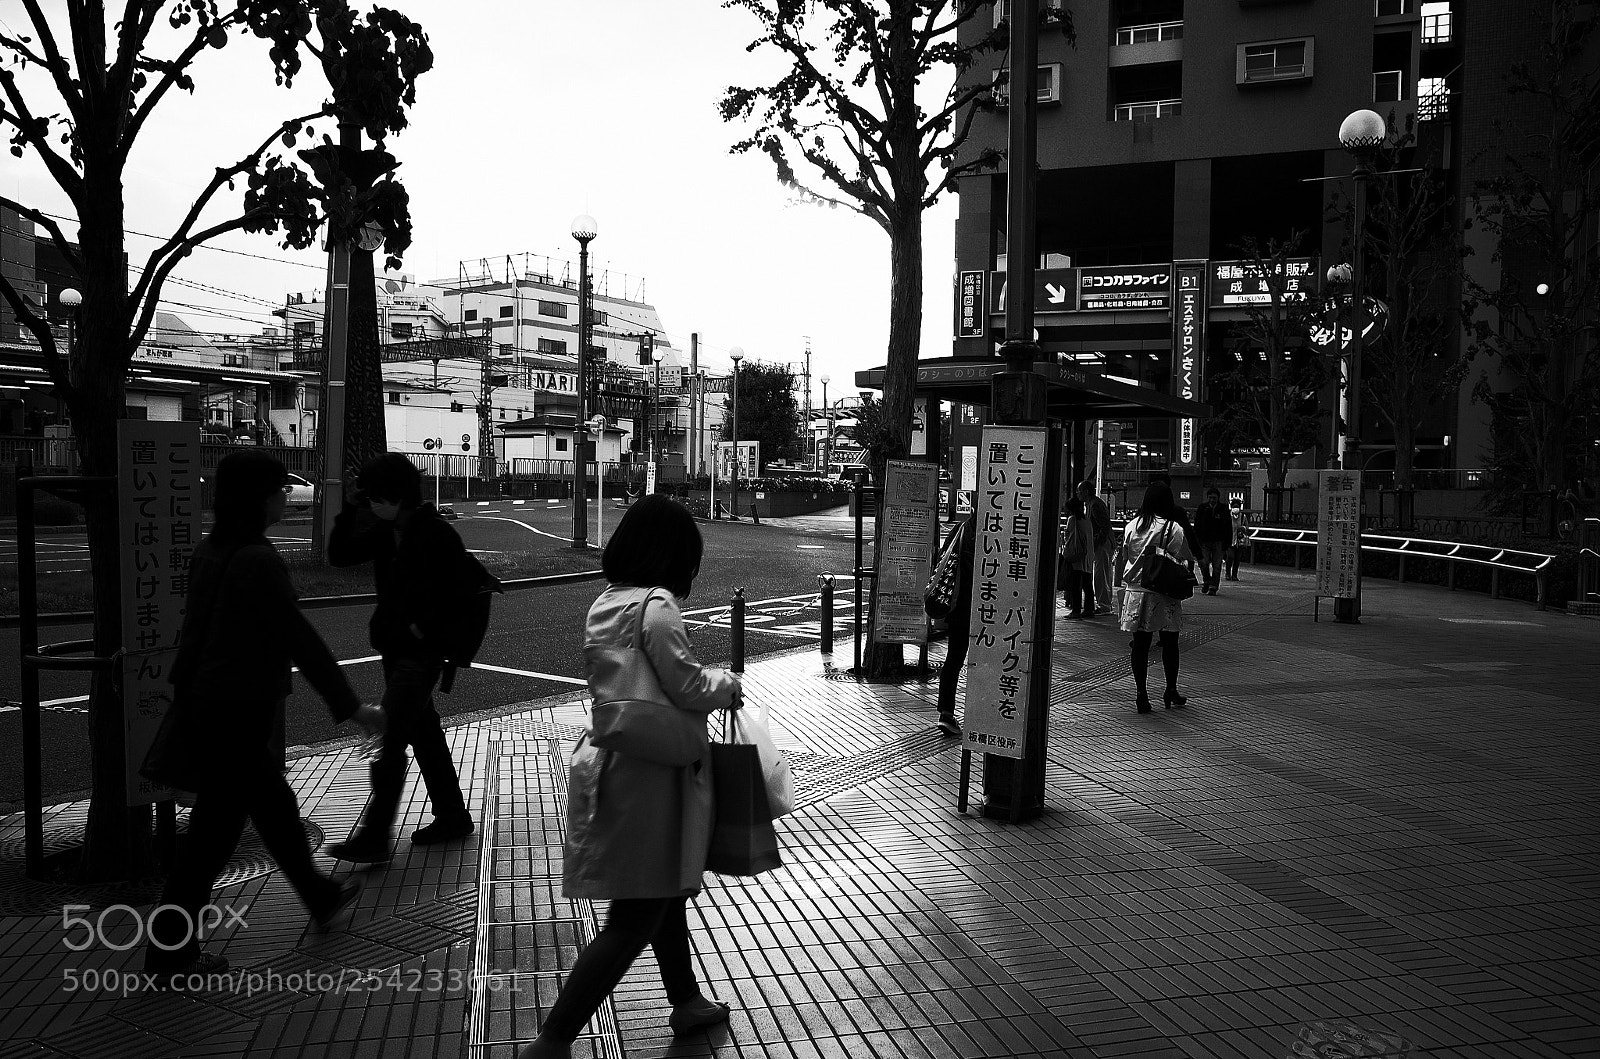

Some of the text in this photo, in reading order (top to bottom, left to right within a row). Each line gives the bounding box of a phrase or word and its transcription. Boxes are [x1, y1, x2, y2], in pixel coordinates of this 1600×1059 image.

[963, 274, 975, 327] 成増図書館
[1093, 274, 1169, 287] ココカラファイン
[1181, 276, 1197, 287] B1
[919, 367, 988, 380] クシーのりば
[1182, 295, 1194, 400] エステサロンさくら
[130, 440, 162, 681] 置いてはいけません
[168, 442, 195, 646] ここに自転車・
[975, 442, 1009, 648] 置いてはいけません
[998, 444, 1036, 721] ここに自転車・バイク等を
[968, 730, 1017, 749] 板橋区役所
